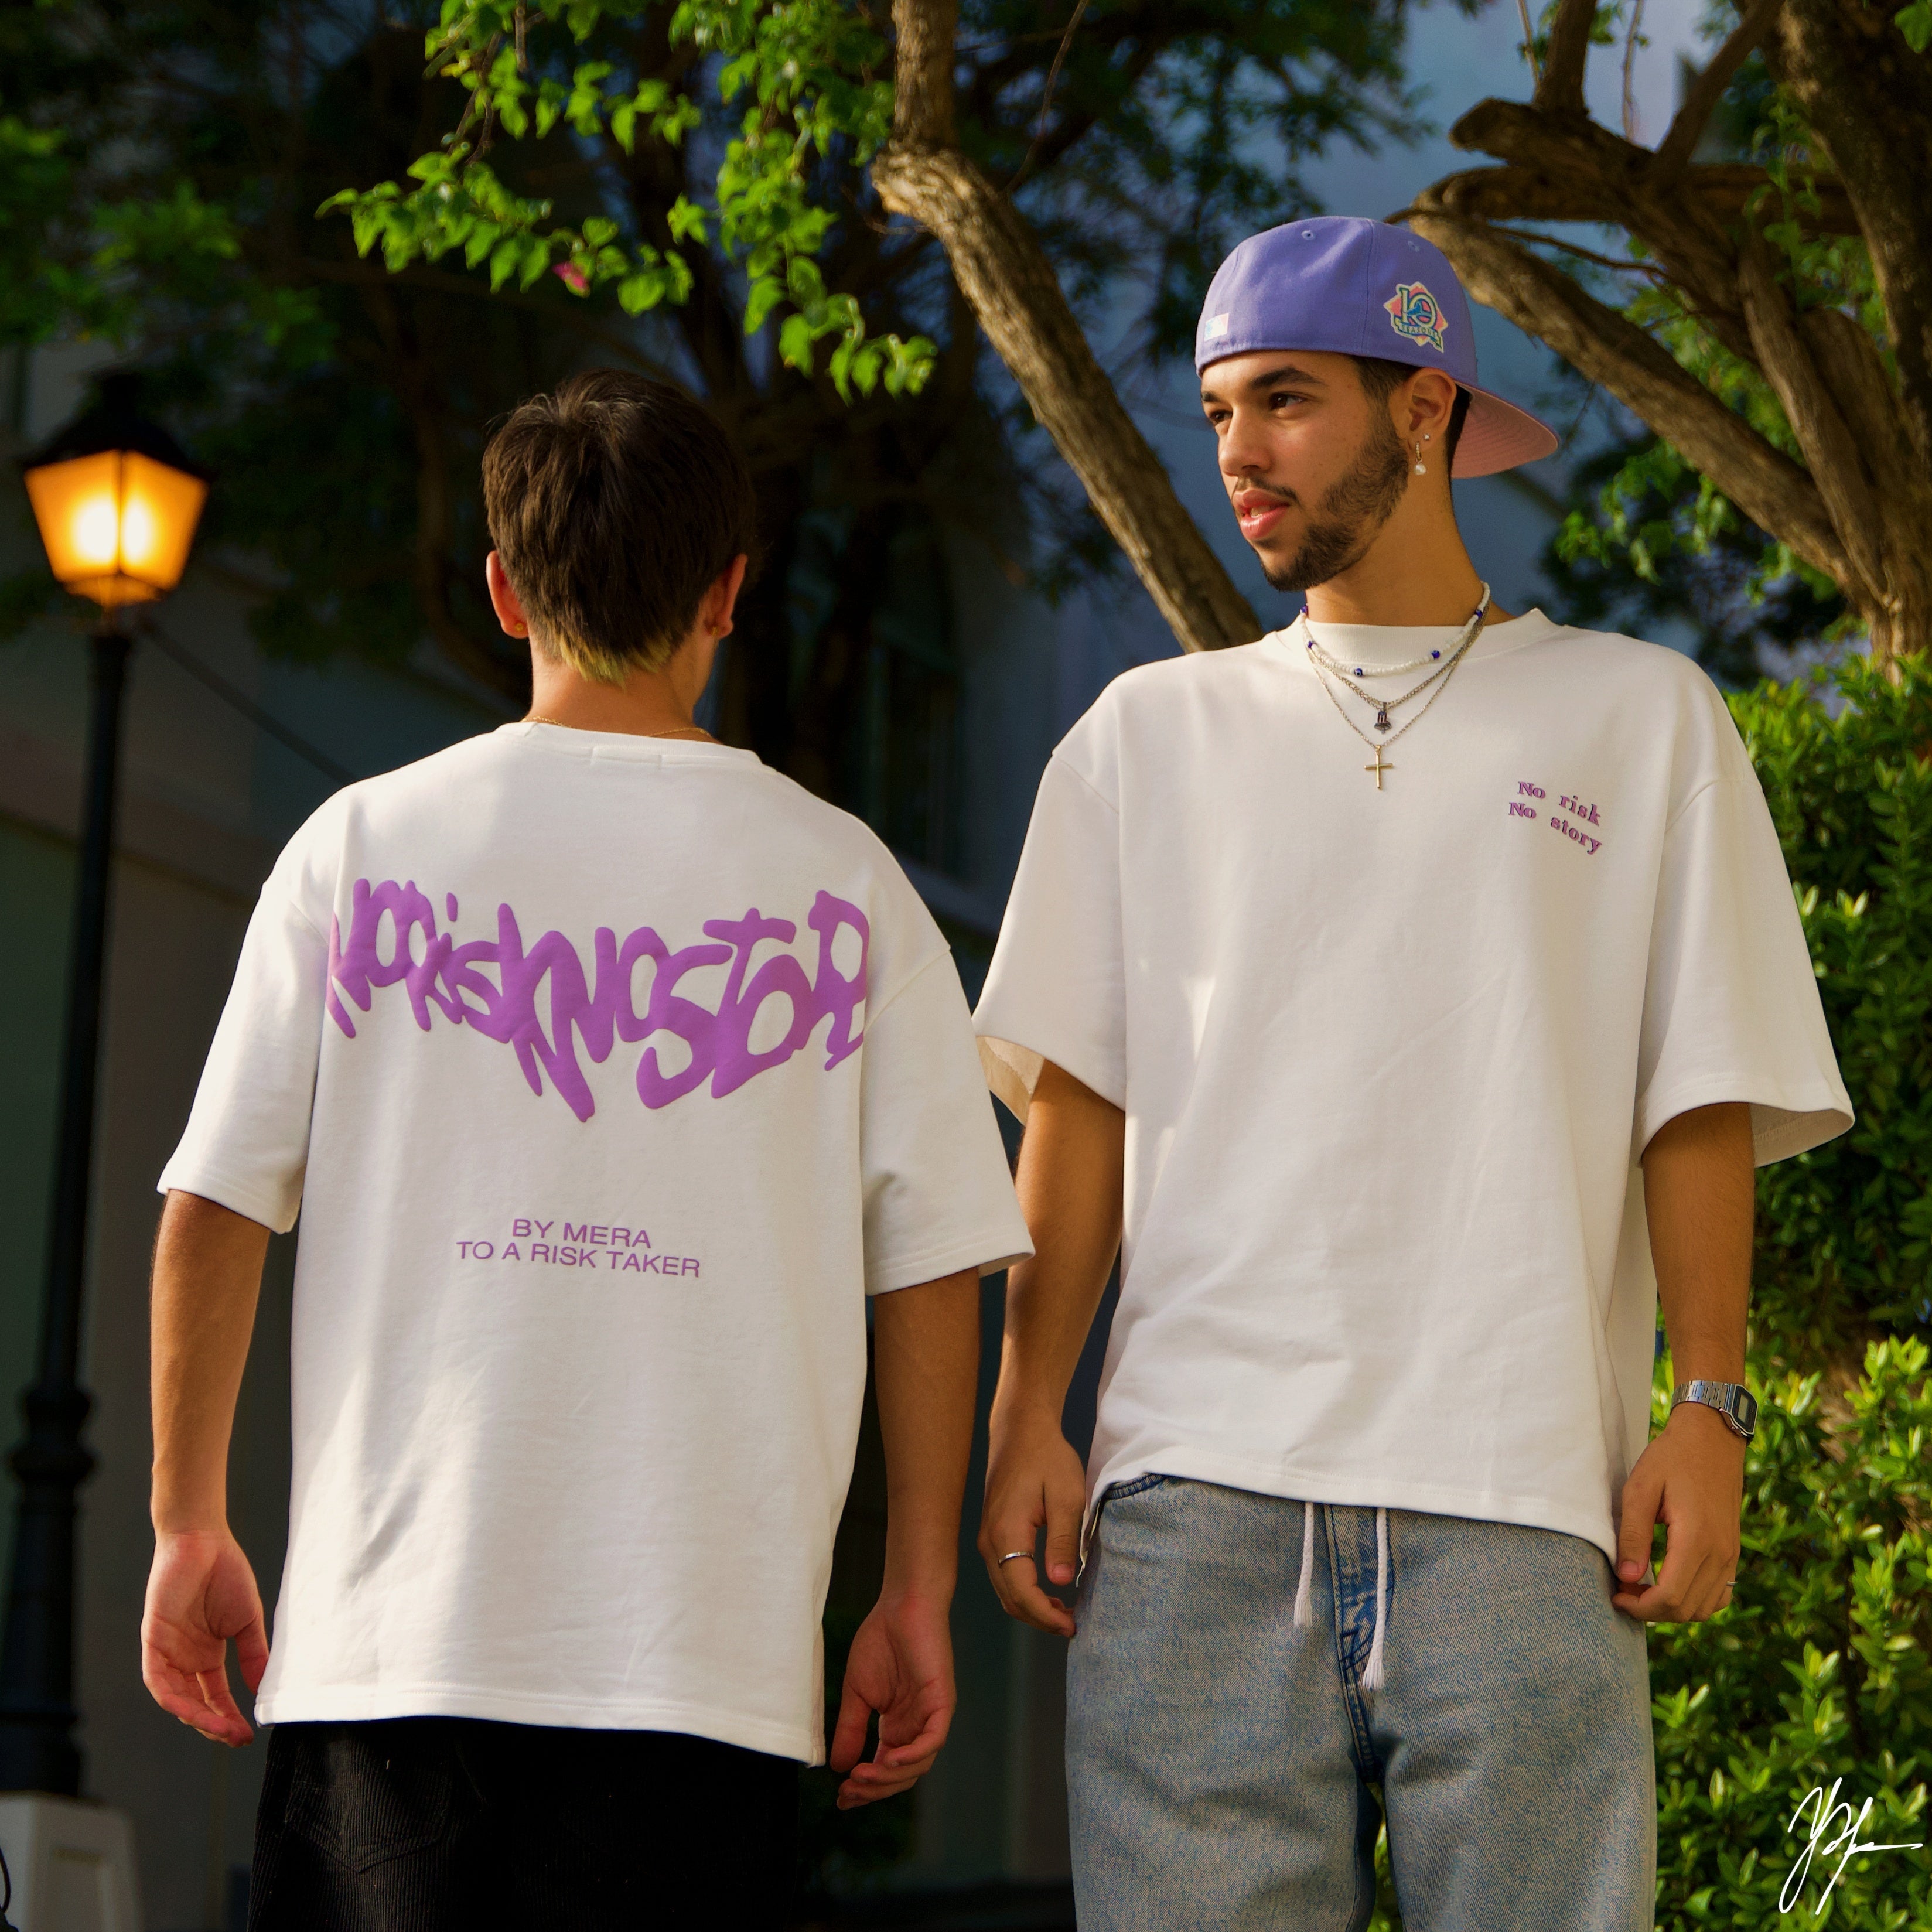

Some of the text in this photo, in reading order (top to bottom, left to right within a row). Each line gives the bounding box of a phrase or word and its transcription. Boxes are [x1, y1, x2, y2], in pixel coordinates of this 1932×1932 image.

[1398, 286, 1437, 329] 10
[1517, 781, 1601, 827] No risk
[1508, 801, 1603, 855] No story
[512, 1218, 651, 1248] BY MERA
[456, 1240, 701, 1278] TO A RISK TAKER
